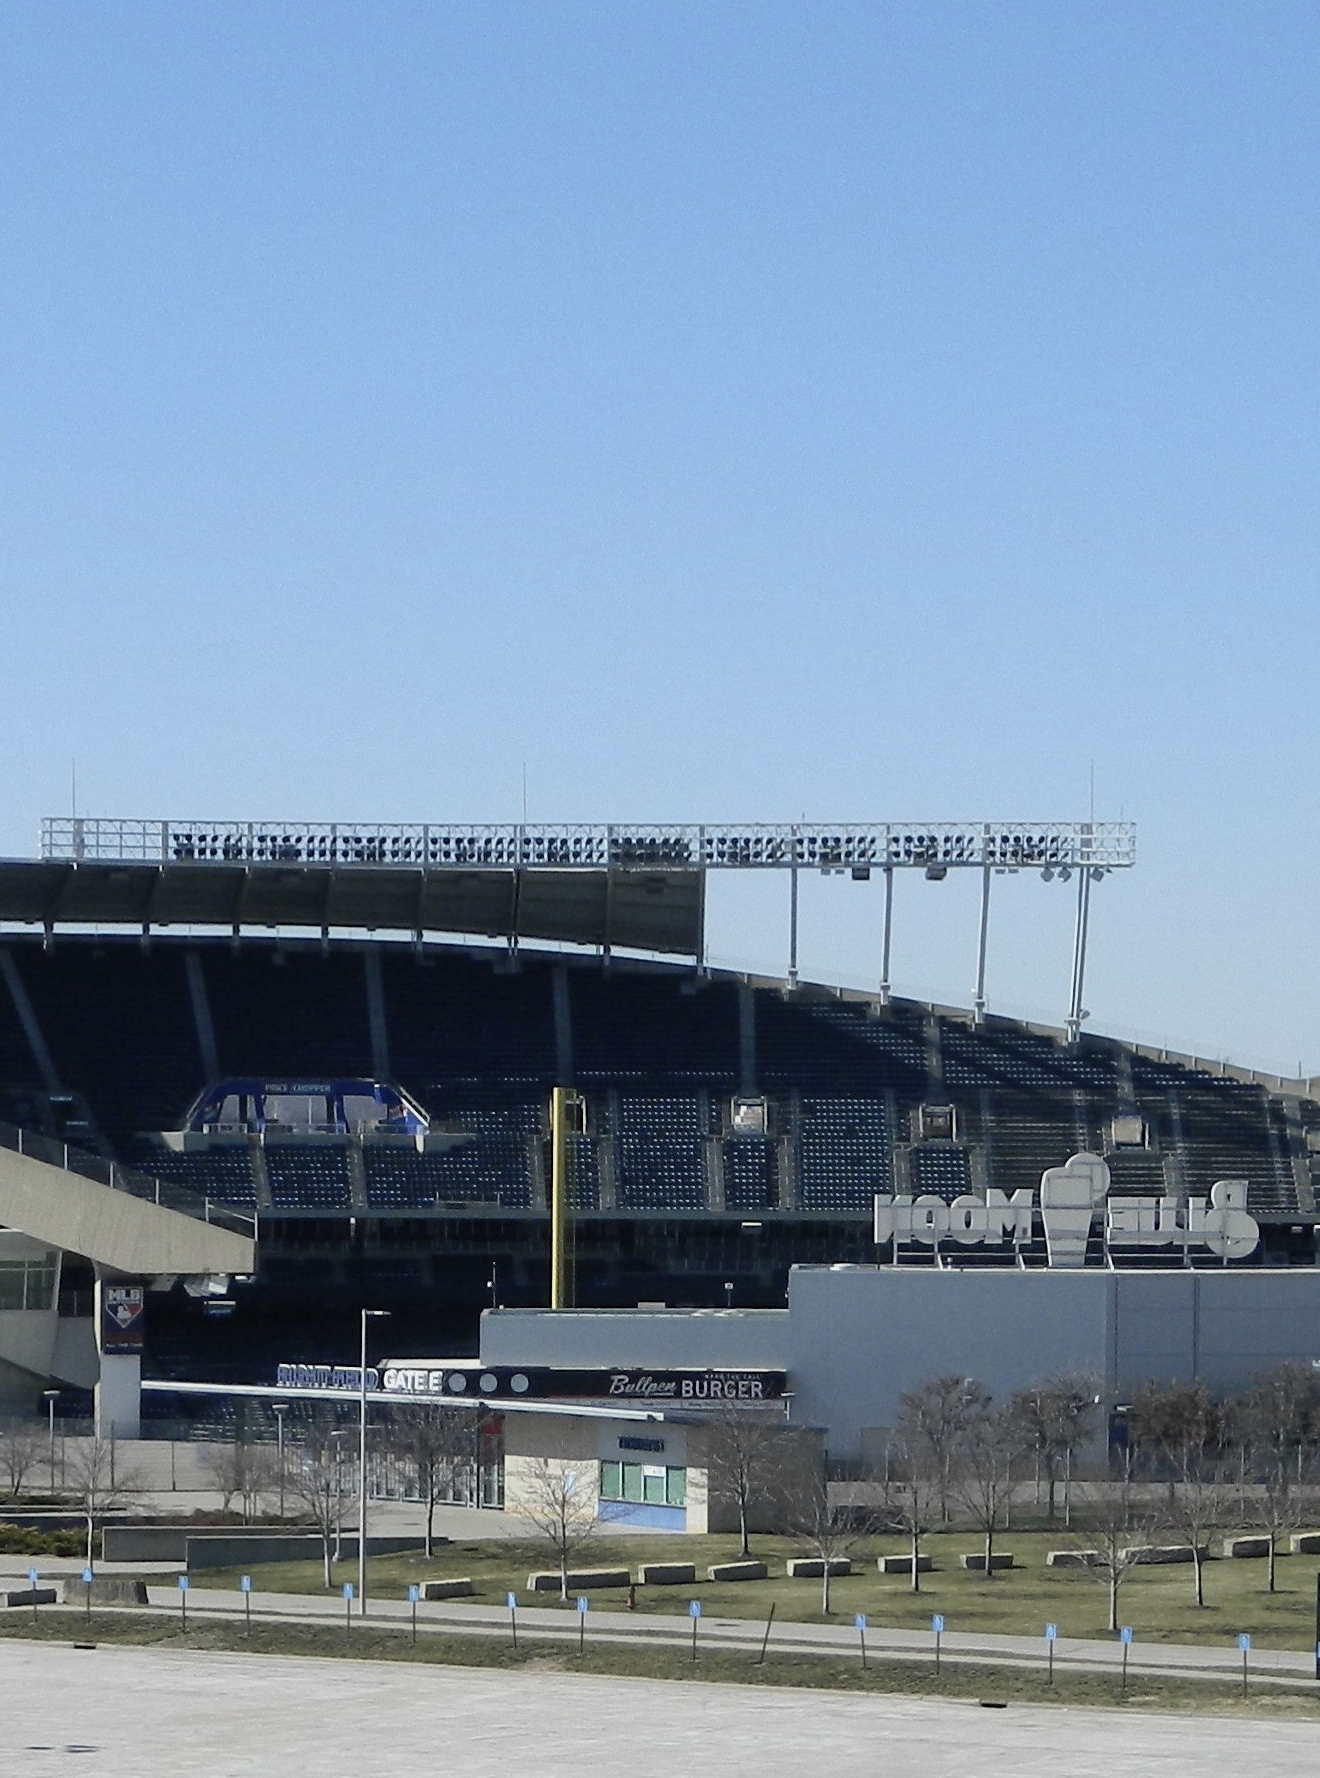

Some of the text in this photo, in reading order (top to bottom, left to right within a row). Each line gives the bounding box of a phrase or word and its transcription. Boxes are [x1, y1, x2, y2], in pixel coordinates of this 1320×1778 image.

[108, 1289, 140, 1300] MLB
[383, 1369, 428, 1391] GATE
[430, 1370, 443, 1391] E
[609, 1374, 763, 1398] Bullpen BURGER
